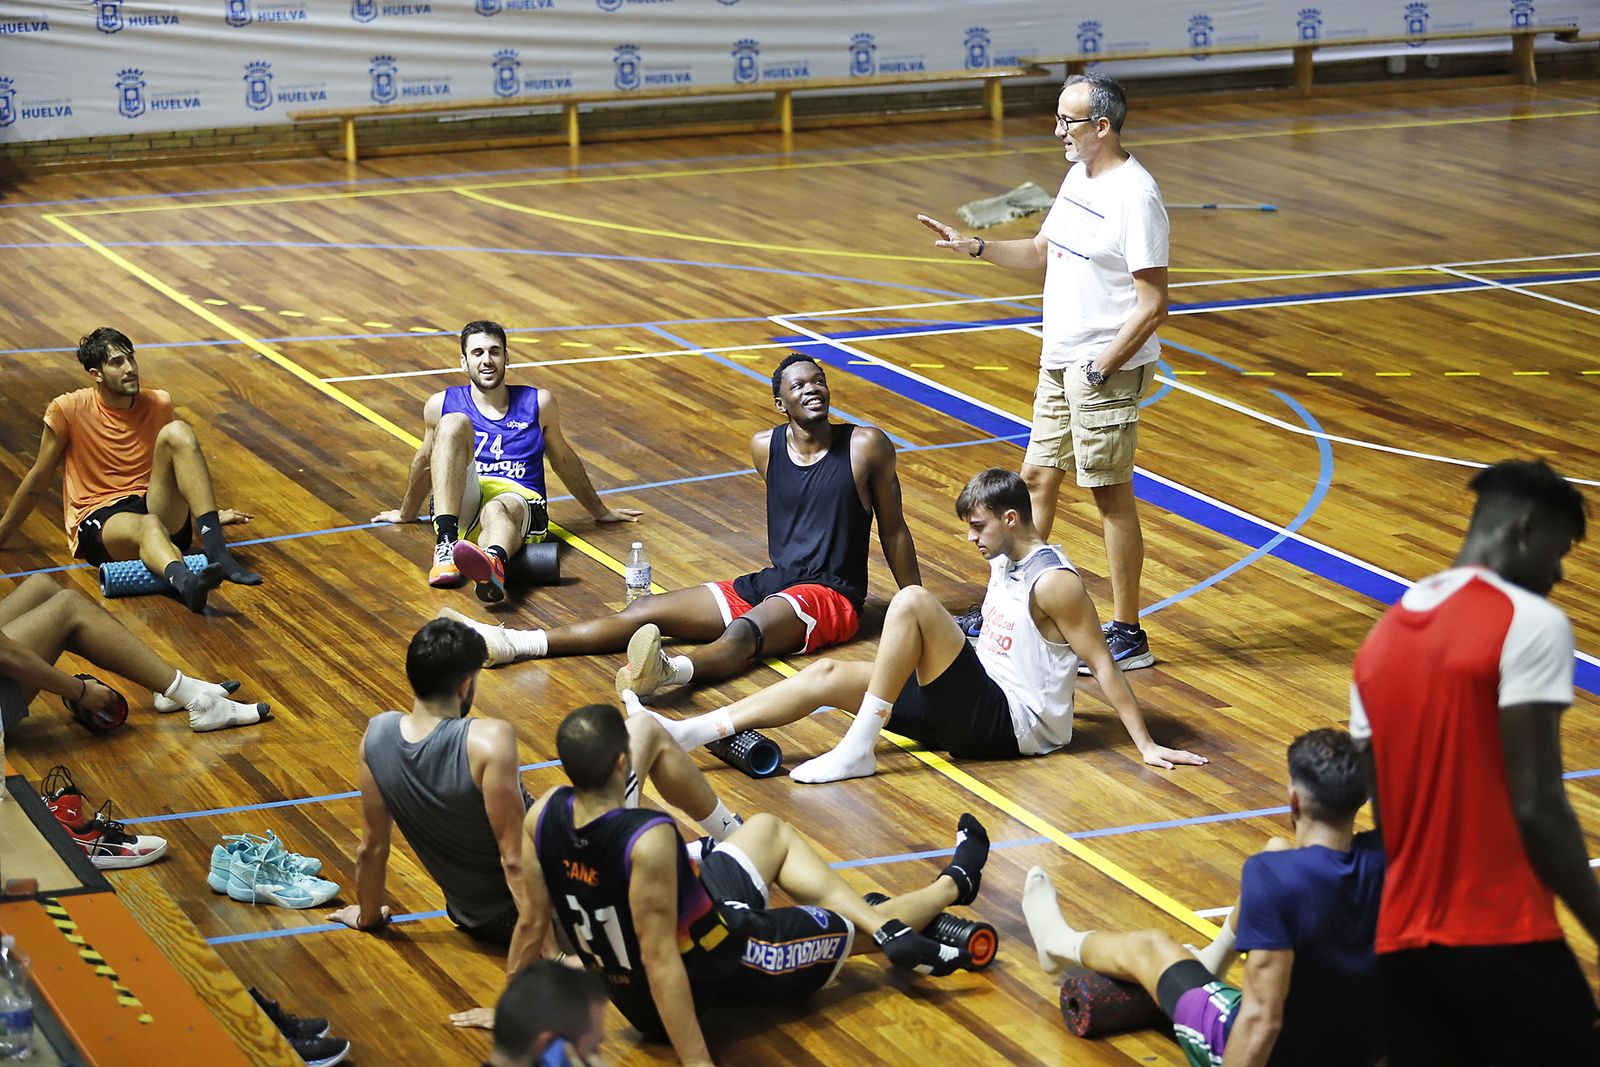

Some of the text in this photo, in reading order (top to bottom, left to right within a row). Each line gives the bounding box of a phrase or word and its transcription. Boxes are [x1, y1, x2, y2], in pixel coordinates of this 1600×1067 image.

[257, 10, 307, 22] HUELVA
[383, 5, 432, 16] HUELVA
[0, 21, 50, 33] HUELVA
[128, 15, 180, 26] HUELVA
[278, 90, 327, 103] HUELVA
[402, 84, 449, 96] HUELVA
[150, 97, 201, 110] HUELVA
[21, 105, 73, 119] HUELVA
[474, 431, 504, 460] 74
[565, 893, 632, 970] 21
[784, 937, 841, 968] ENRIQUE
